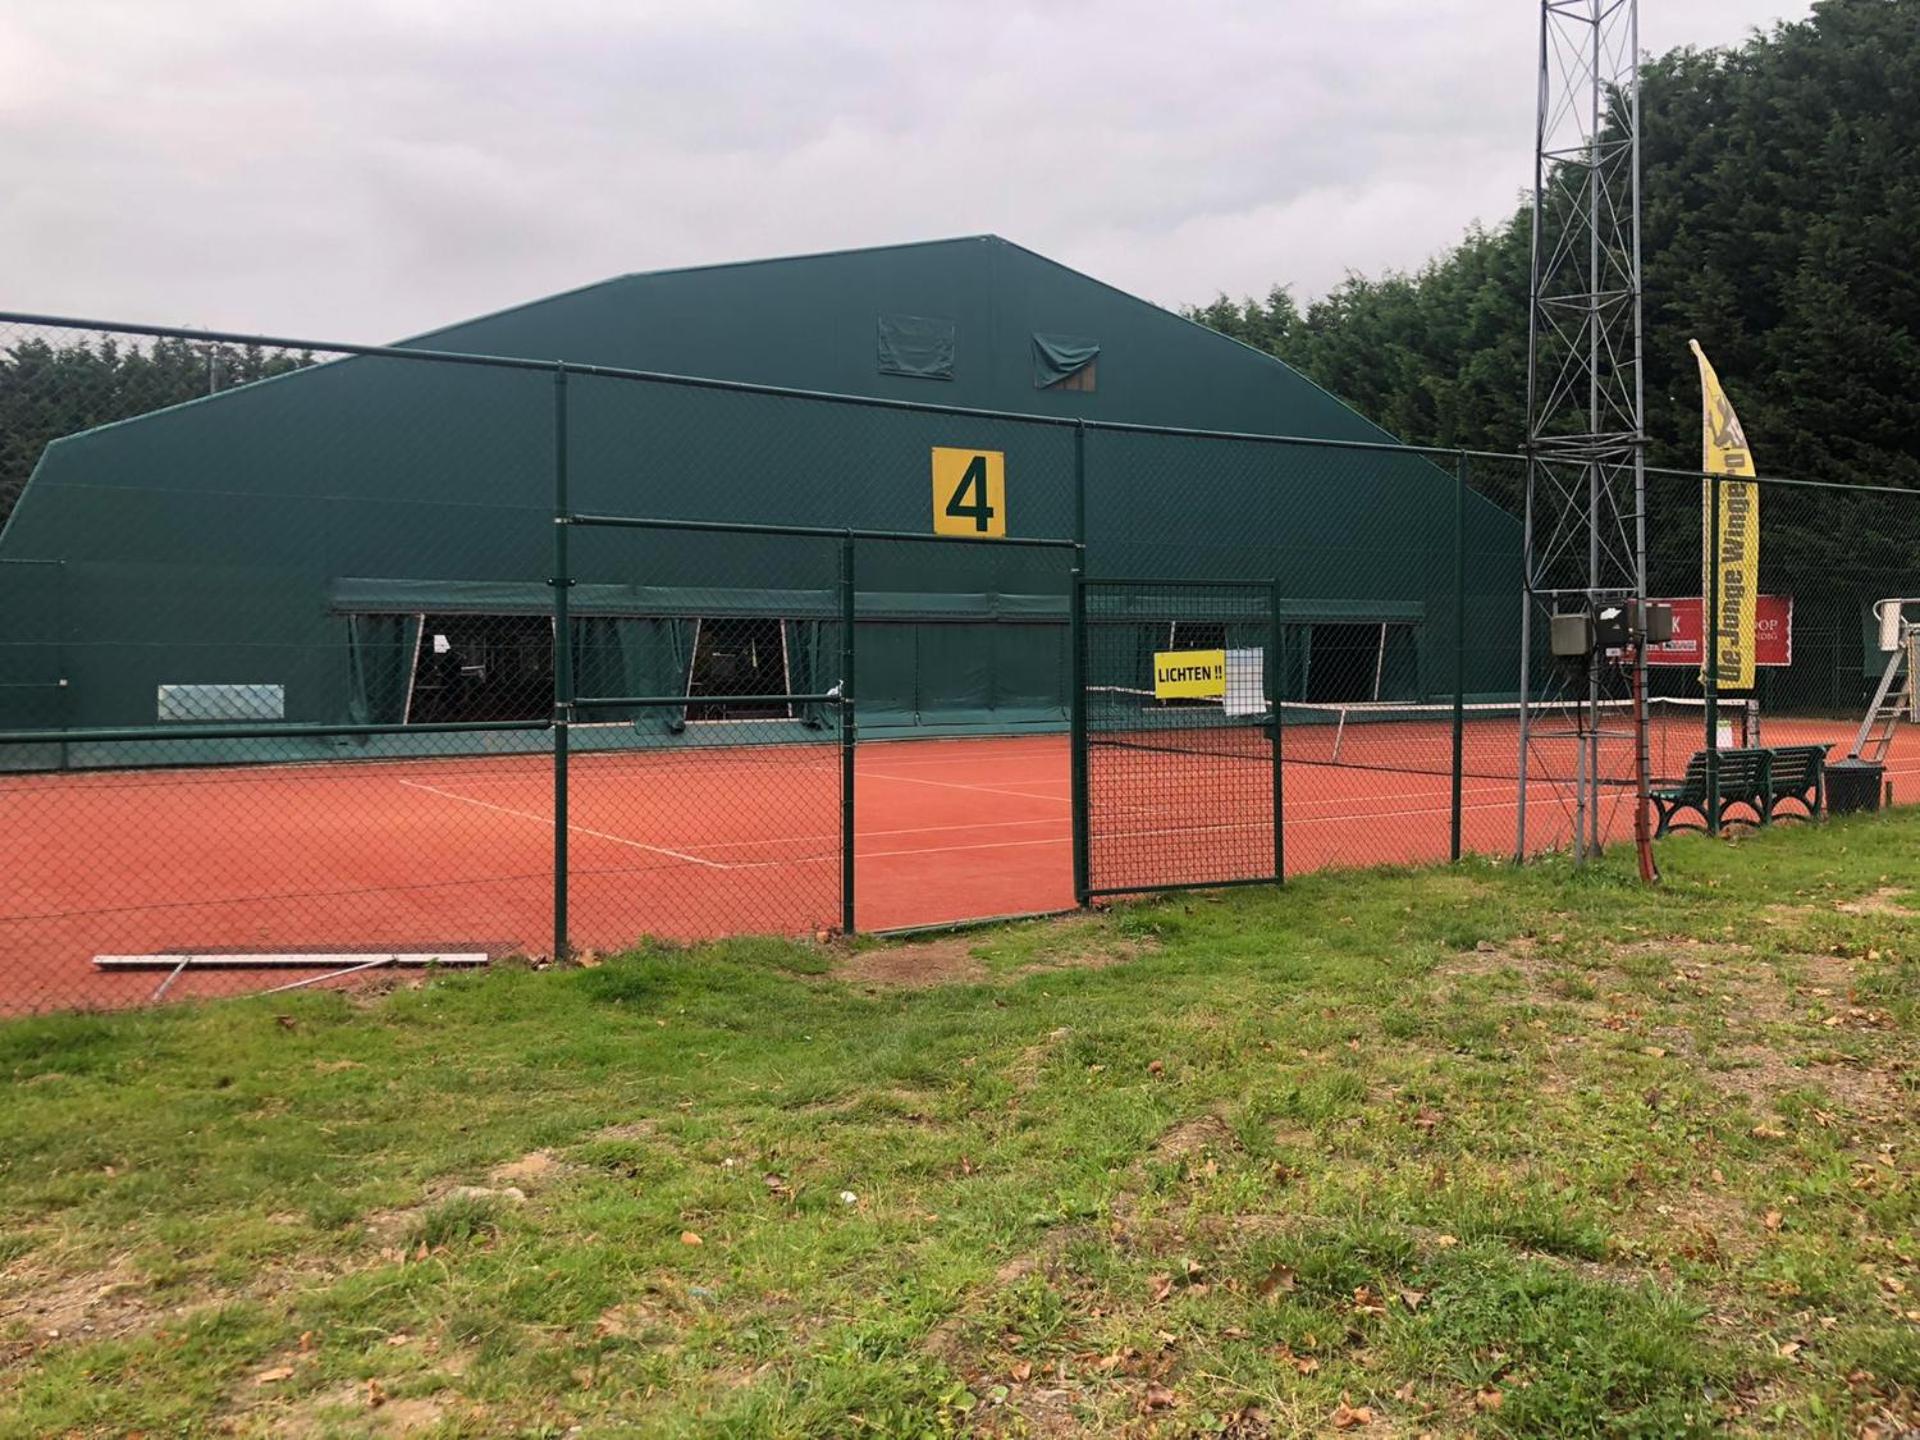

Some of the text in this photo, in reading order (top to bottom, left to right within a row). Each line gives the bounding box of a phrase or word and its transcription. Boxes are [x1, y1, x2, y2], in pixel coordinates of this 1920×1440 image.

[946, 456, 994, 532] 4
[1717, 570, 1744, 646] Jonge
[1158, 665, 1222, 682] LICHTEN !!
[1716, 650, 1741, 681] De
